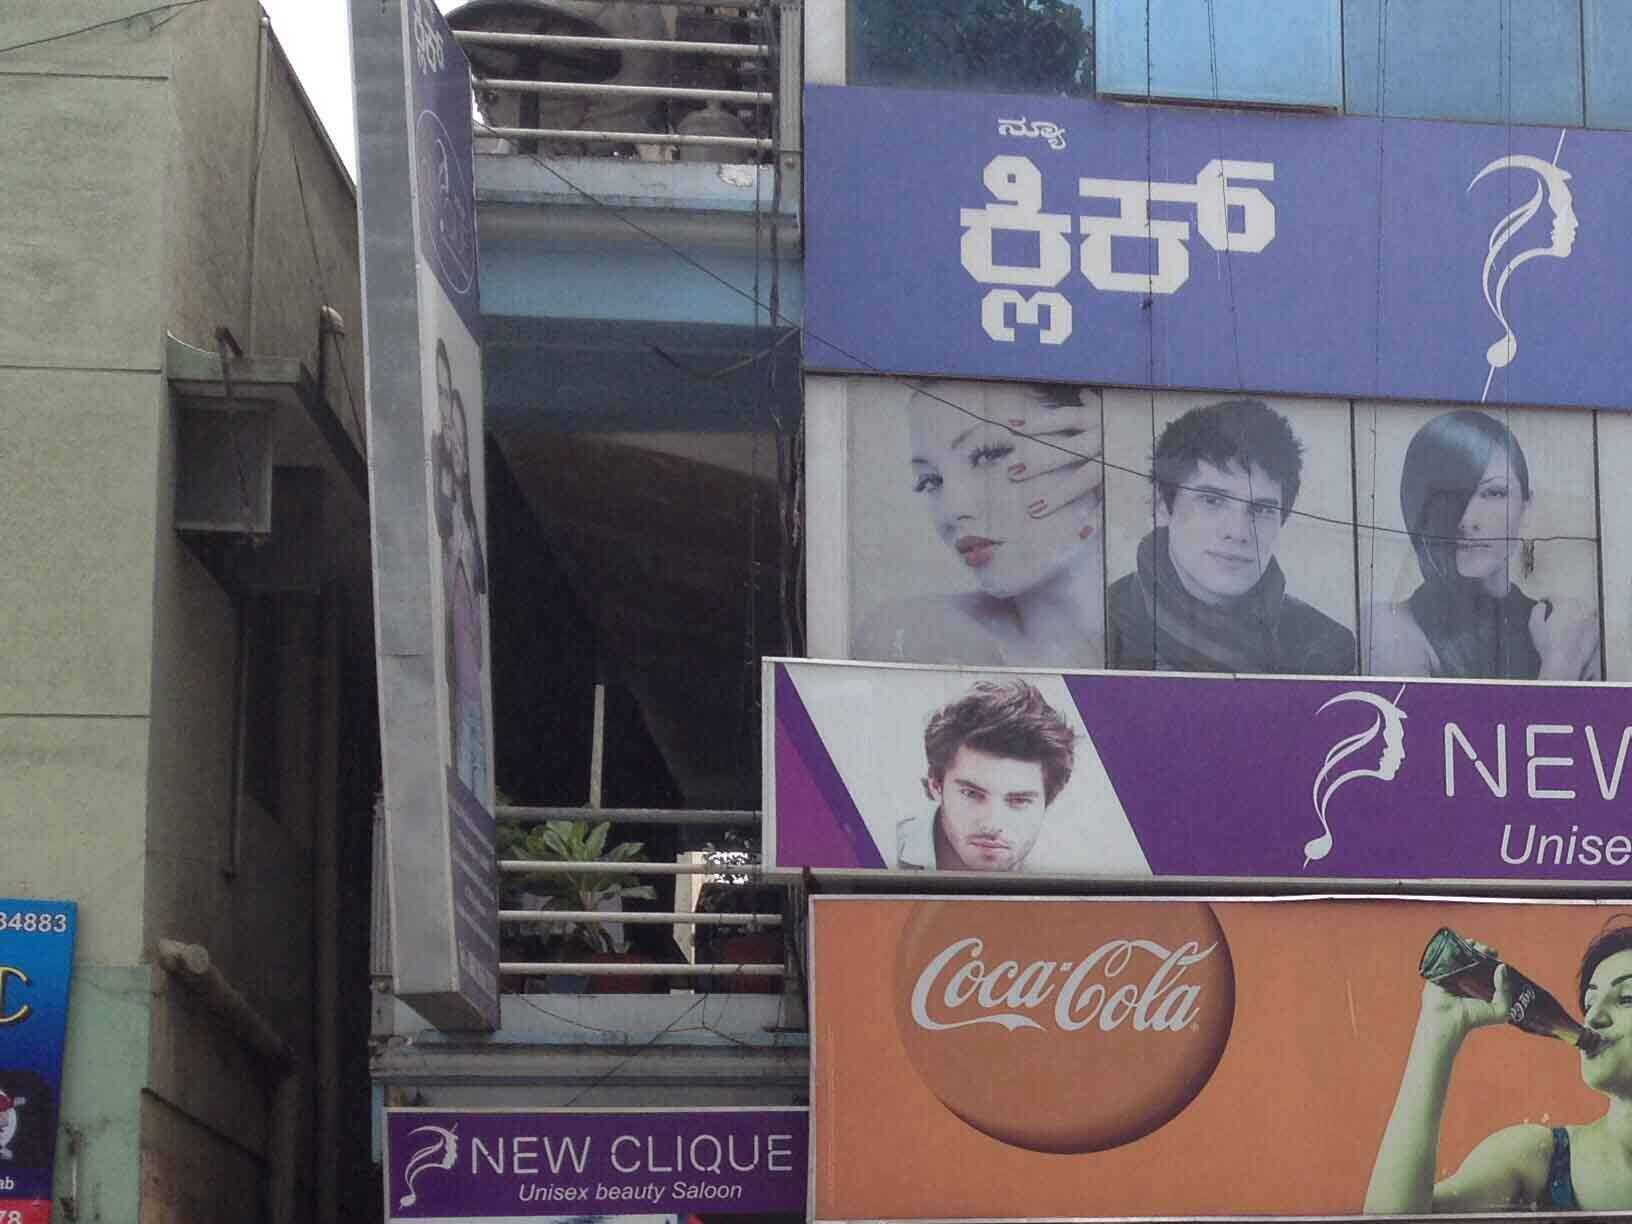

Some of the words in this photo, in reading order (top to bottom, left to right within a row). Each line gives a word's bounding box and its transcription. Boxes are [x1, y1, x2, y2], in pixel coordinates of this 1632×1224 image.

[997, 117, 1067, 150] ನ್ಯೂ
[959, 154, 1276, 345] ಕ್ಲಿಕ್
[911, 937, 1219, 1032] Coca-Cola
[471, 1136, 591, 1175] NEW
[610, 1134, 793, 1175] CLIQUE
[518, 1183, 589, 1202] Unisex
[595, 1183, 666, 1204] beauty
[671, 1181, 743, 1201] Saloon
